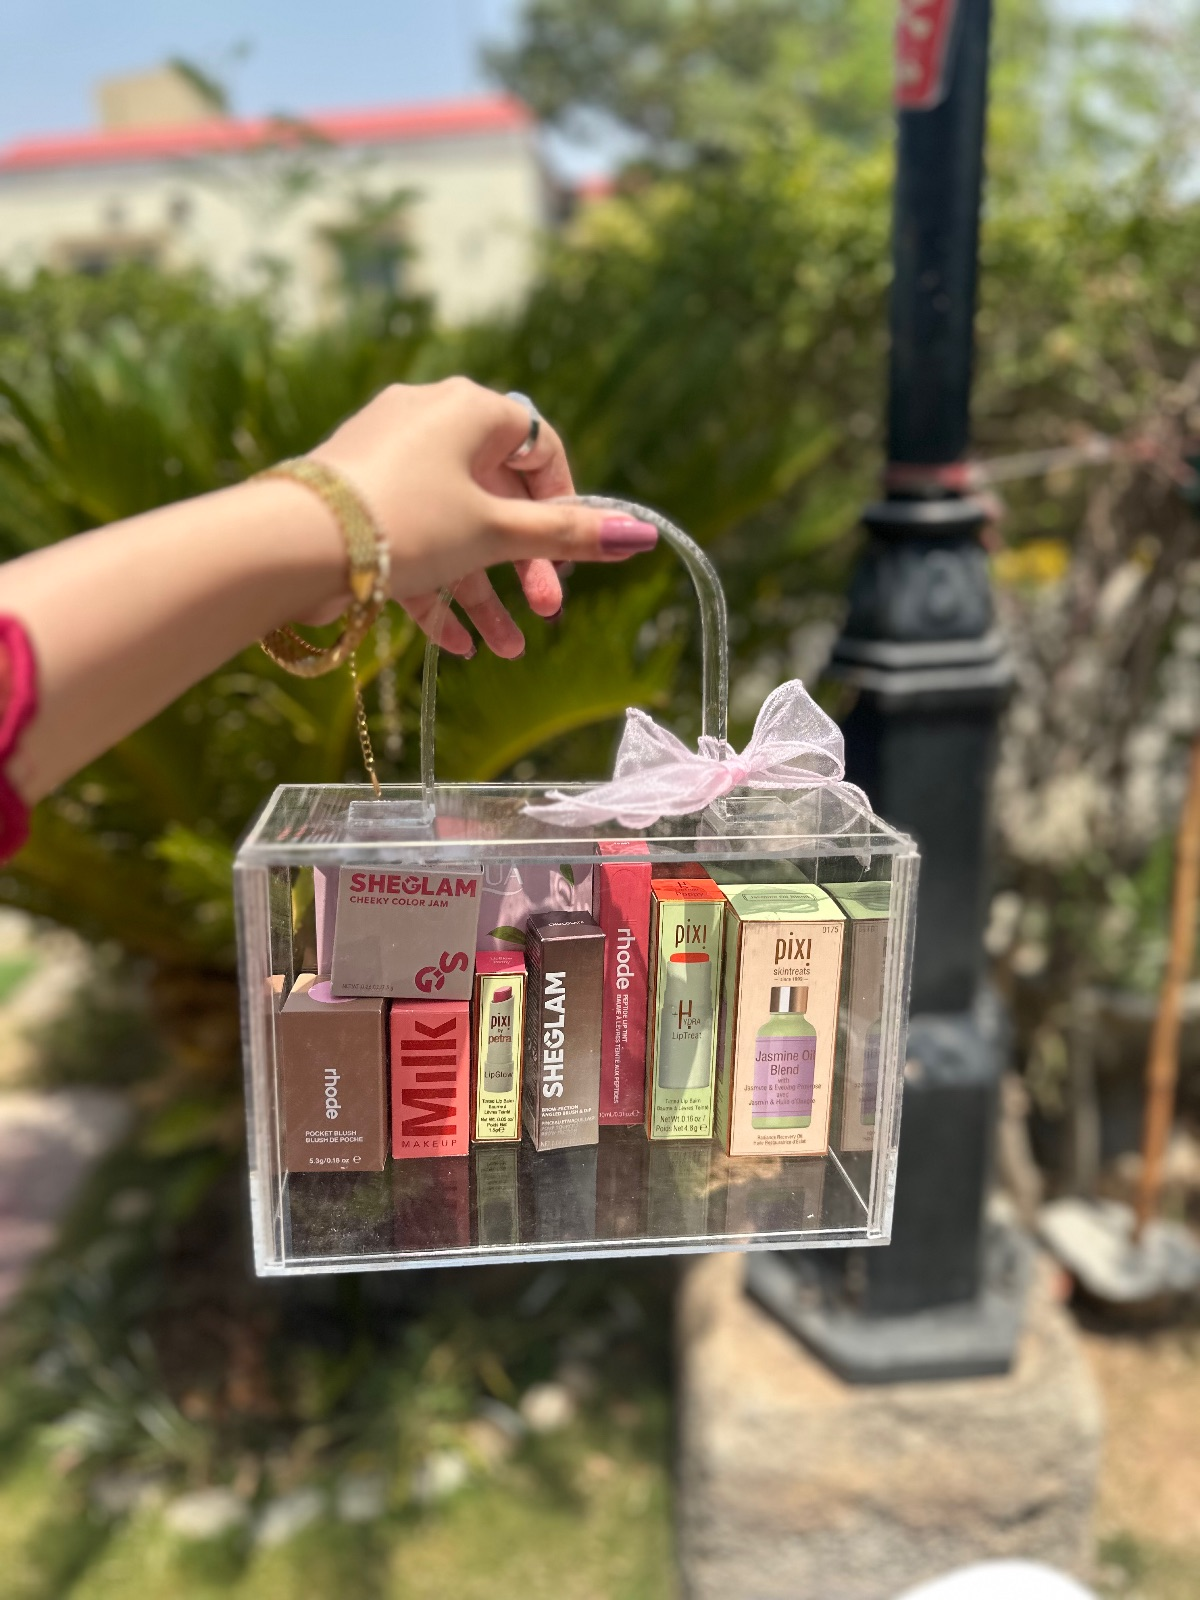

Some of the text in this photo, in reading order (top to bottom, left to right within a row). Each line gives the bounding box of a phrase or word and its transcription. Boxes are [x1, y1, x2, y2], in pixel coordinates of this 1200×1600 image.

[350, 873, 477, 898] SHEGLAM
[350, 896, 449, 908] CHEEKY COLOR JAM
[616, 928, 636, 990] rhode
[773, 968, 810, 976] skintreats
[488, 1034, 512, 1044] petra
[542, 971, 566, 1098] SHEGLAM
[672, 1031, 702, 1040] LipTreat
[755, 1049, 816, 1062] Jasmine Oil
[770, 1064, 799, 1076] Blend
[400, 1017, 457, 1136] Milk
[325, 1068, 342, 1120] rhode
[402, 1140, 456, 1148] MAKEUP
